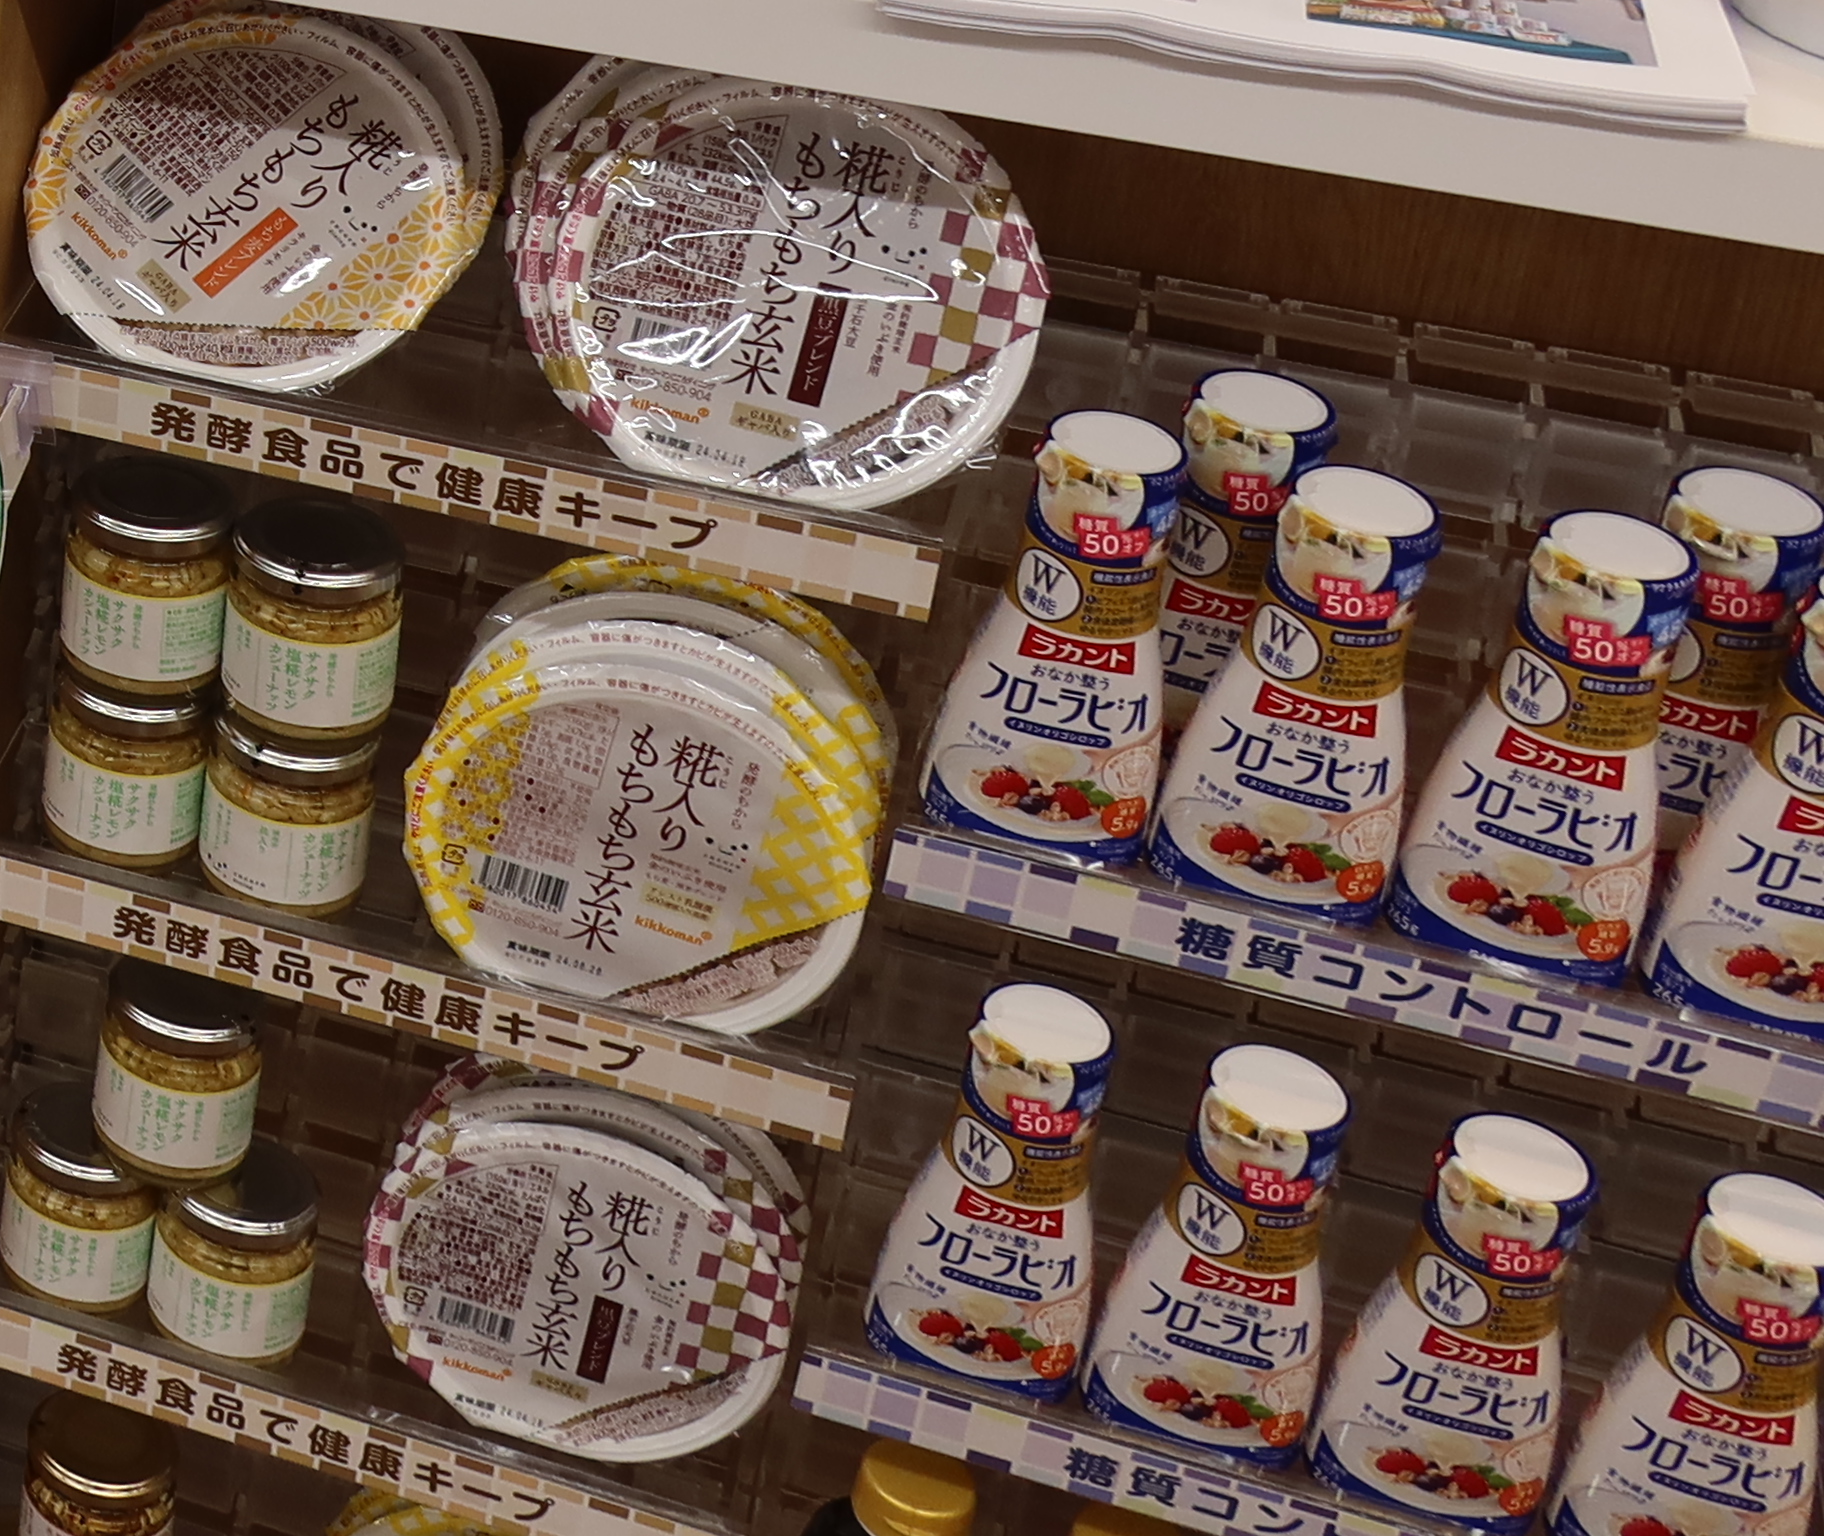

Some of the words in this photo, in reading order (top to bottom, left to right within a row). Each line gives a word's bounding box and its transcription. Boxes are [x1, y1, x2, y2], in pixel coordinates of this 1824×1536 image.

[151, 94, 360, 271] もちもち玄米
[292, 120, 390, 209] 糀入り
[71, 211, 118, 262] kikkoman
[831, 143, 895, 273] 糀入り
[723, 133, 826, 396] もちもち玄米
[150, 400, 720, 550] 発酵食品で健康キープ
[1078, 517, 1109, 534] 糖質
[1085, 535, 1120, 556] 50
[1023, 586, 1058, 614] 機能
[1031, 554, 1063, 593] W
[1030, 632, 1129, 668] ラカント
[1031, 663, 1111, 691] おなか整う
[980, 661, 1149, 733] フローラビオ
[654, 736, 725, 852] 糀入り
[1508, 767, 1595, 804] おなか整う
[1509, 733, 1620, 781] ラカント
[564, 725, 659, 953] もちもち玄米
[1451, 761, 1639, 852] フローラビオ
[635, 916, 704, 946] kikkoman
[112, 904, 646, 1072] 発酵食品で健康キープ
[1176, 918, 1708, 1076] 糖質コントロール
[599, 1191, 652, 1292] 糀入り
[918, 1212, 1078, 1290] フローラビオ
[965, 1197, 1058, 1232] ラカント
[520, 1183, 594, 1371] もちもち玄米
[56, 1344, 556, 1522] 発酵食品で健康キープ
